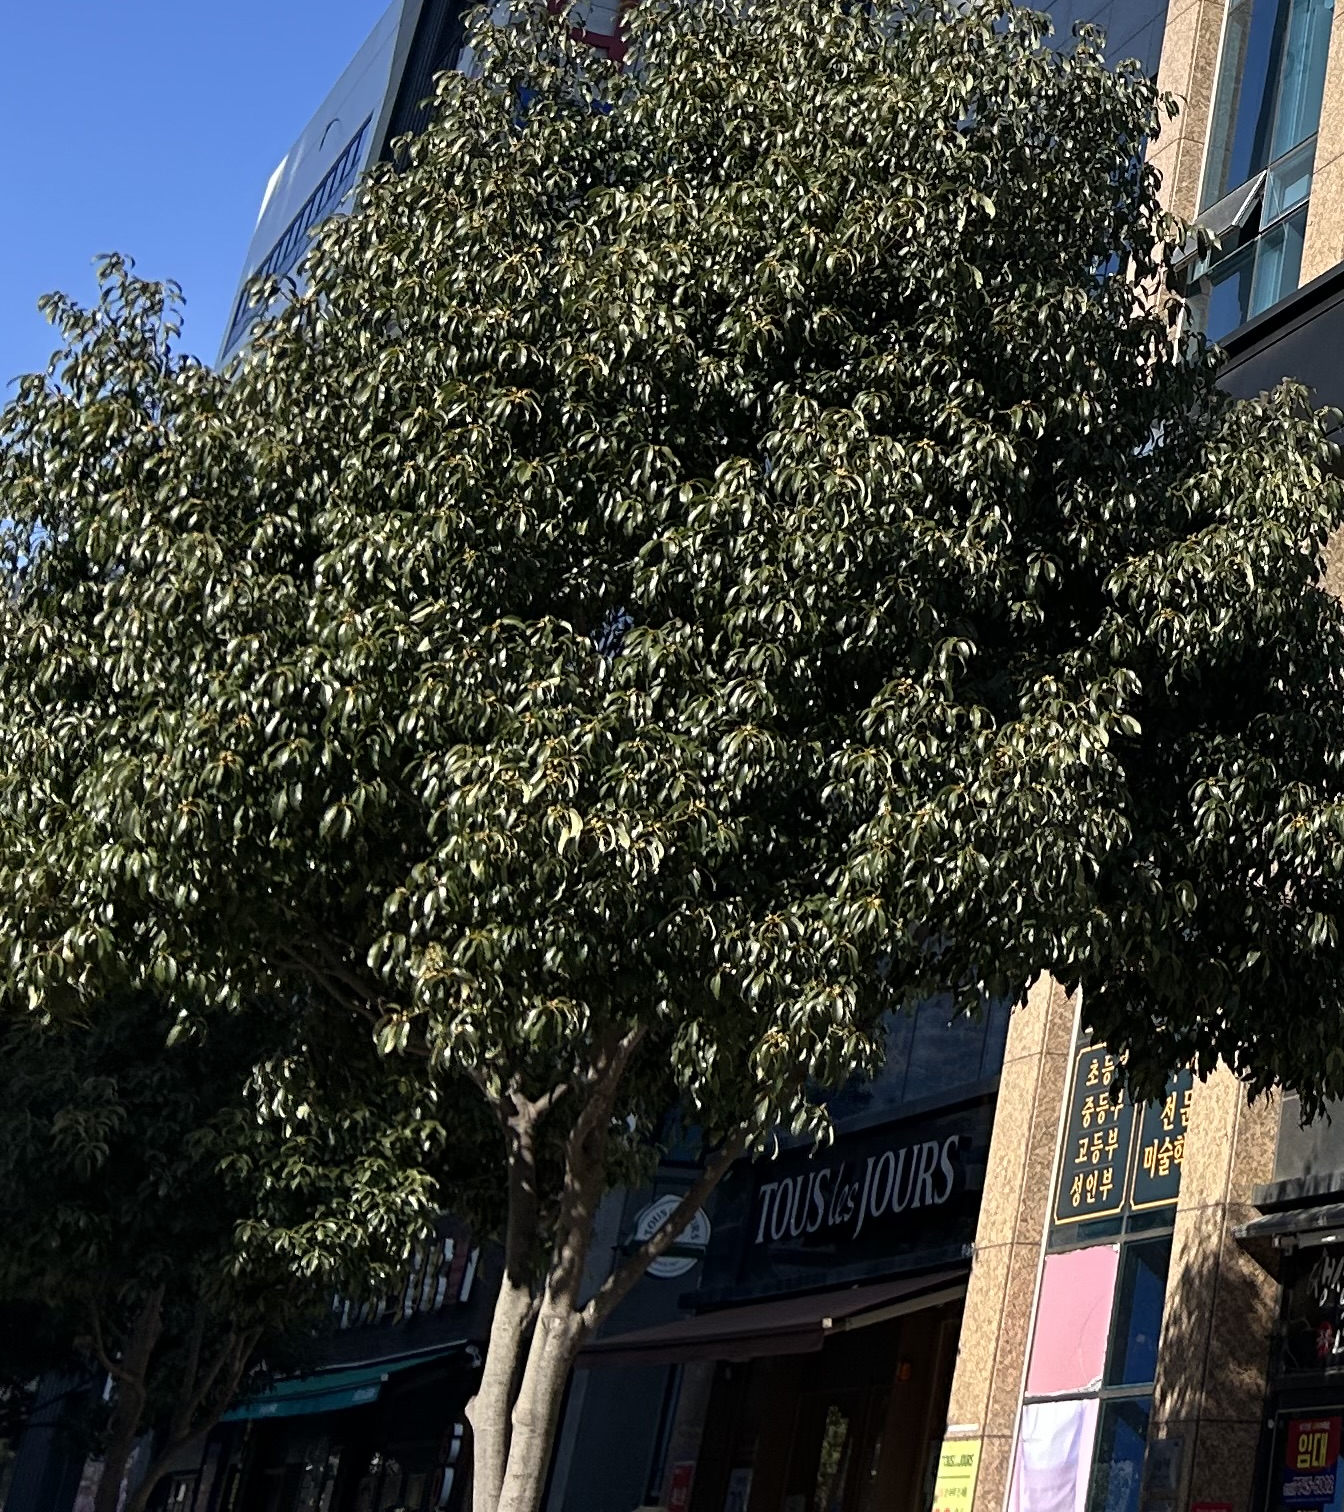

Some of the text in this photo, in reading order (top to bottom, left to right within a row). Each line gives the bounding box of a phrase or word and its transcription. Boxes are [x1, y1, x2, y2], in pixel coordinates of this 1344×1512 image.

[1086, 1049, 1129, 1086] 초등
[1075, 1128, 1119, 1164] 고등부
[755, 1134, 961, 1245] TOUS les JOURS
[1070, 1168, 1114, 1207] 성인부
[1296, 1431, 1329, 1469] 임대
